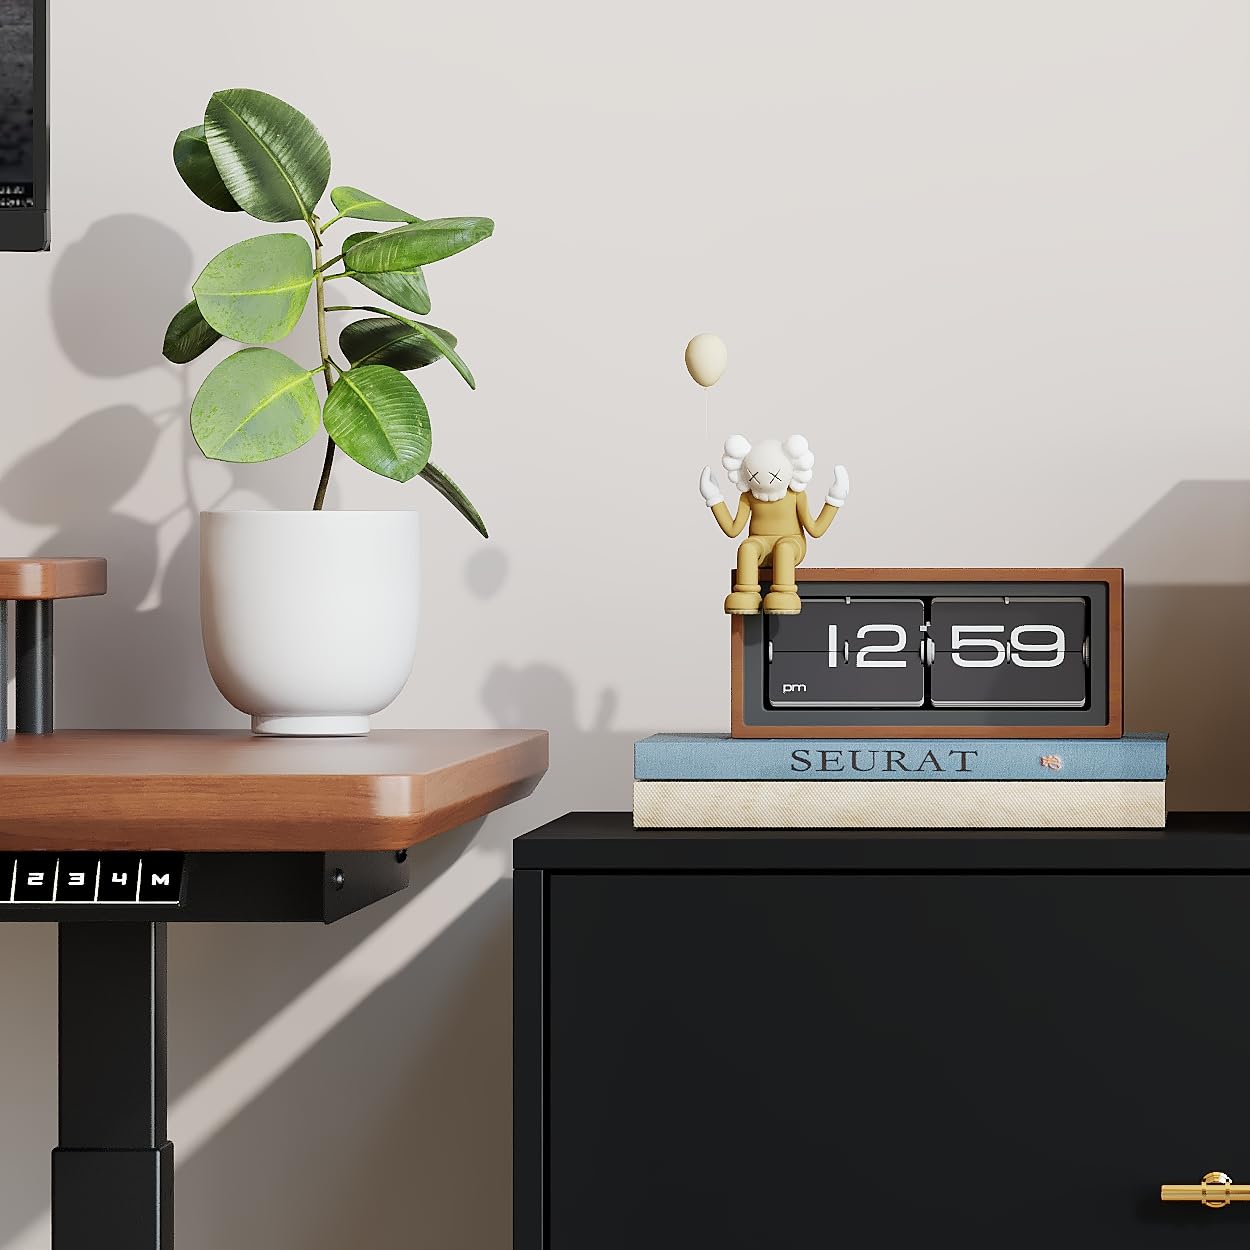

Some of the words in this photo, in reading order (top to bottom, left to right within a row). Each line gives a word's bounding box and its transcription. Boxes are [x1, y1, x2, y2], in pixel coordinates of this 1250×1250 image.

[828, 624, 908, 668] 12
[950, 624, 1066, 668] 59
[782, 682, 807, 694] pm
[790, 749, 979, 773] SEURAT
[27, 872, 45, 886] 2
[67, 872, 86, 886] 3
[111, 872, 128, 886] 4
[151, 873, 170, 886] M
